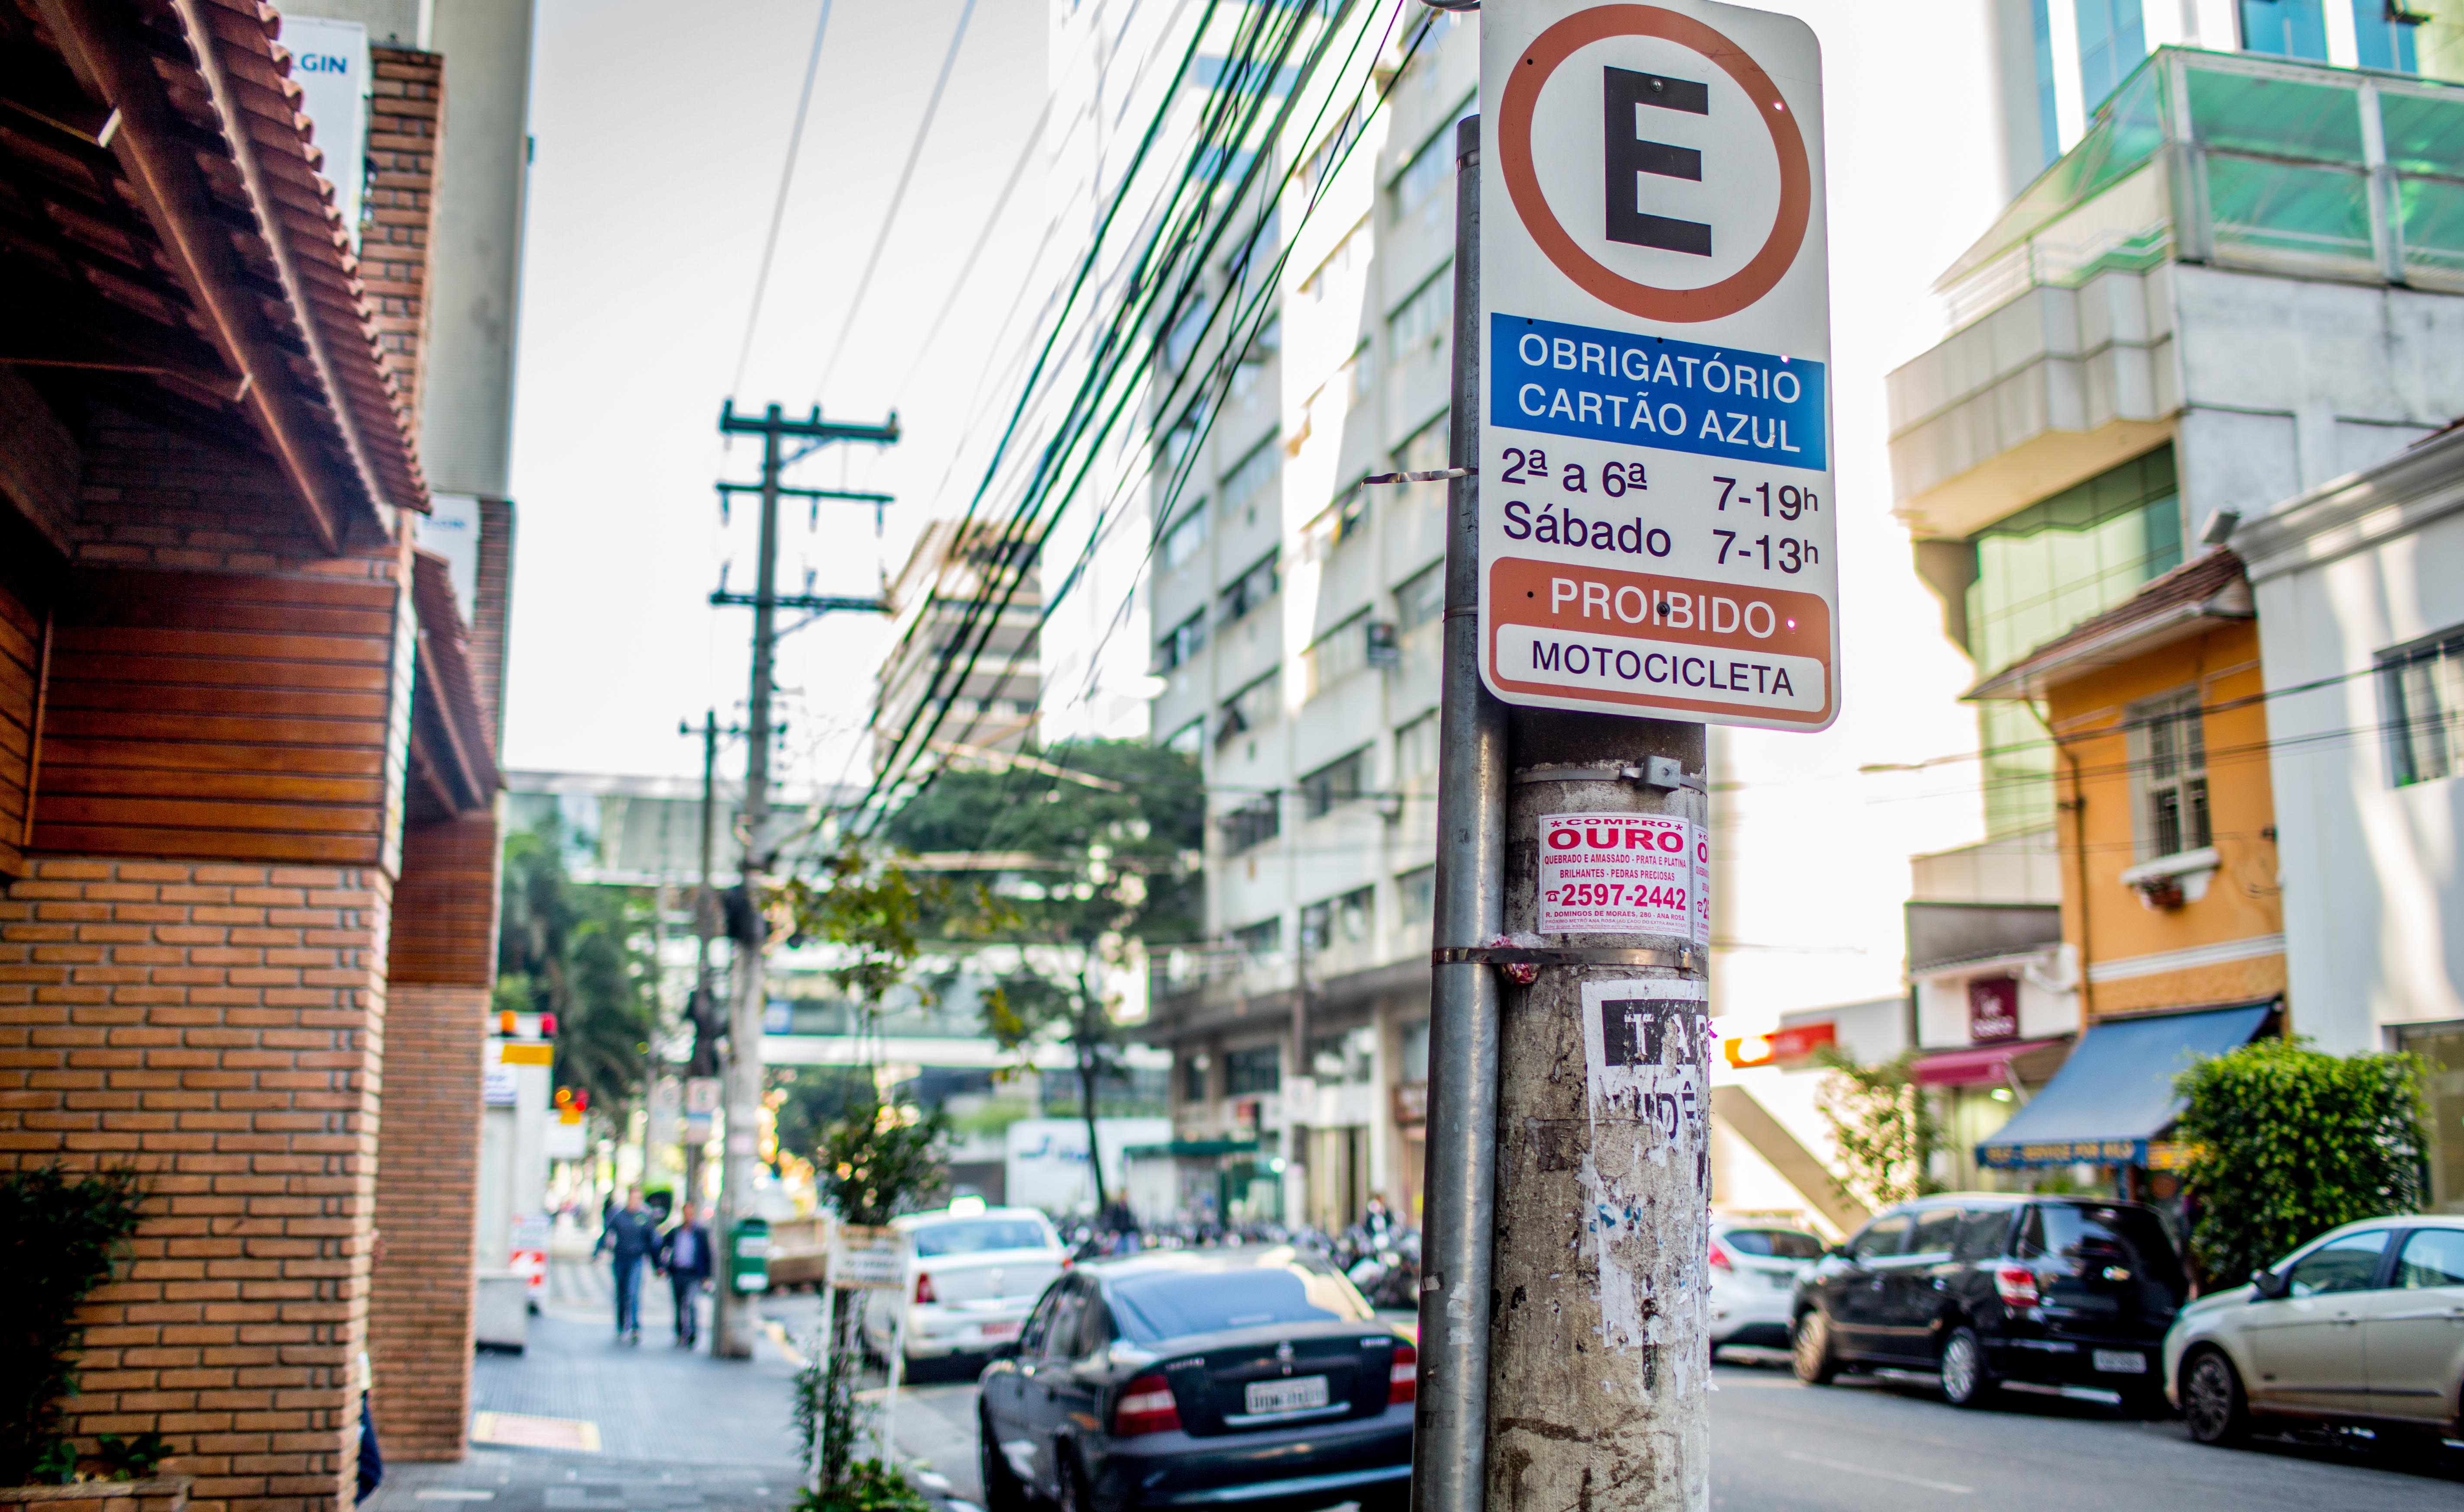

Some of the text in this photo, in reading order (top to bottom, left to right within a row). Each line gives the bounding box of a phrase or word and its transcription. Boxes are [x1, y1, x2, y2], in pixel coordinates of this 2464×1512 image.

[1604, 65, 1712, 257] E
[1519, 333, 1800, 404] OBRIGATÓRIO
[1519, 383, 1800, 453] CARTÃO AZUL
[1502, 447, 1818, 521] 2ª a 6ª 7-19h
[1503, 500, 1818, 574] Sábado 7-13h
[1551, 578, 1775, 639] PROIBIDO
[1532, 640, 1794, 696] MOTOCICLETA
[1548, 828, 1683, 853] OURO
[1566, 819, 1671, 828] COMPRO
[1545, 854, 1582, 864] QUEBRADO
[1584, 854, 1588, 863] E
[1591, 854, 1630, 863] AMASSADO
[1636, 855, 1657, 865] PRATA
[1659, 856, 1662, 865] E
[1664, 857, 1686, 869] PLATINA
[1560, 869, 1605, 878] BRILHANTES
[1611, 869, 1638, 878] PEDRAS
[1640, 870, 1675, 881] PRECIOSAS
[1562, 883, 1686, 911] 2597-2442
